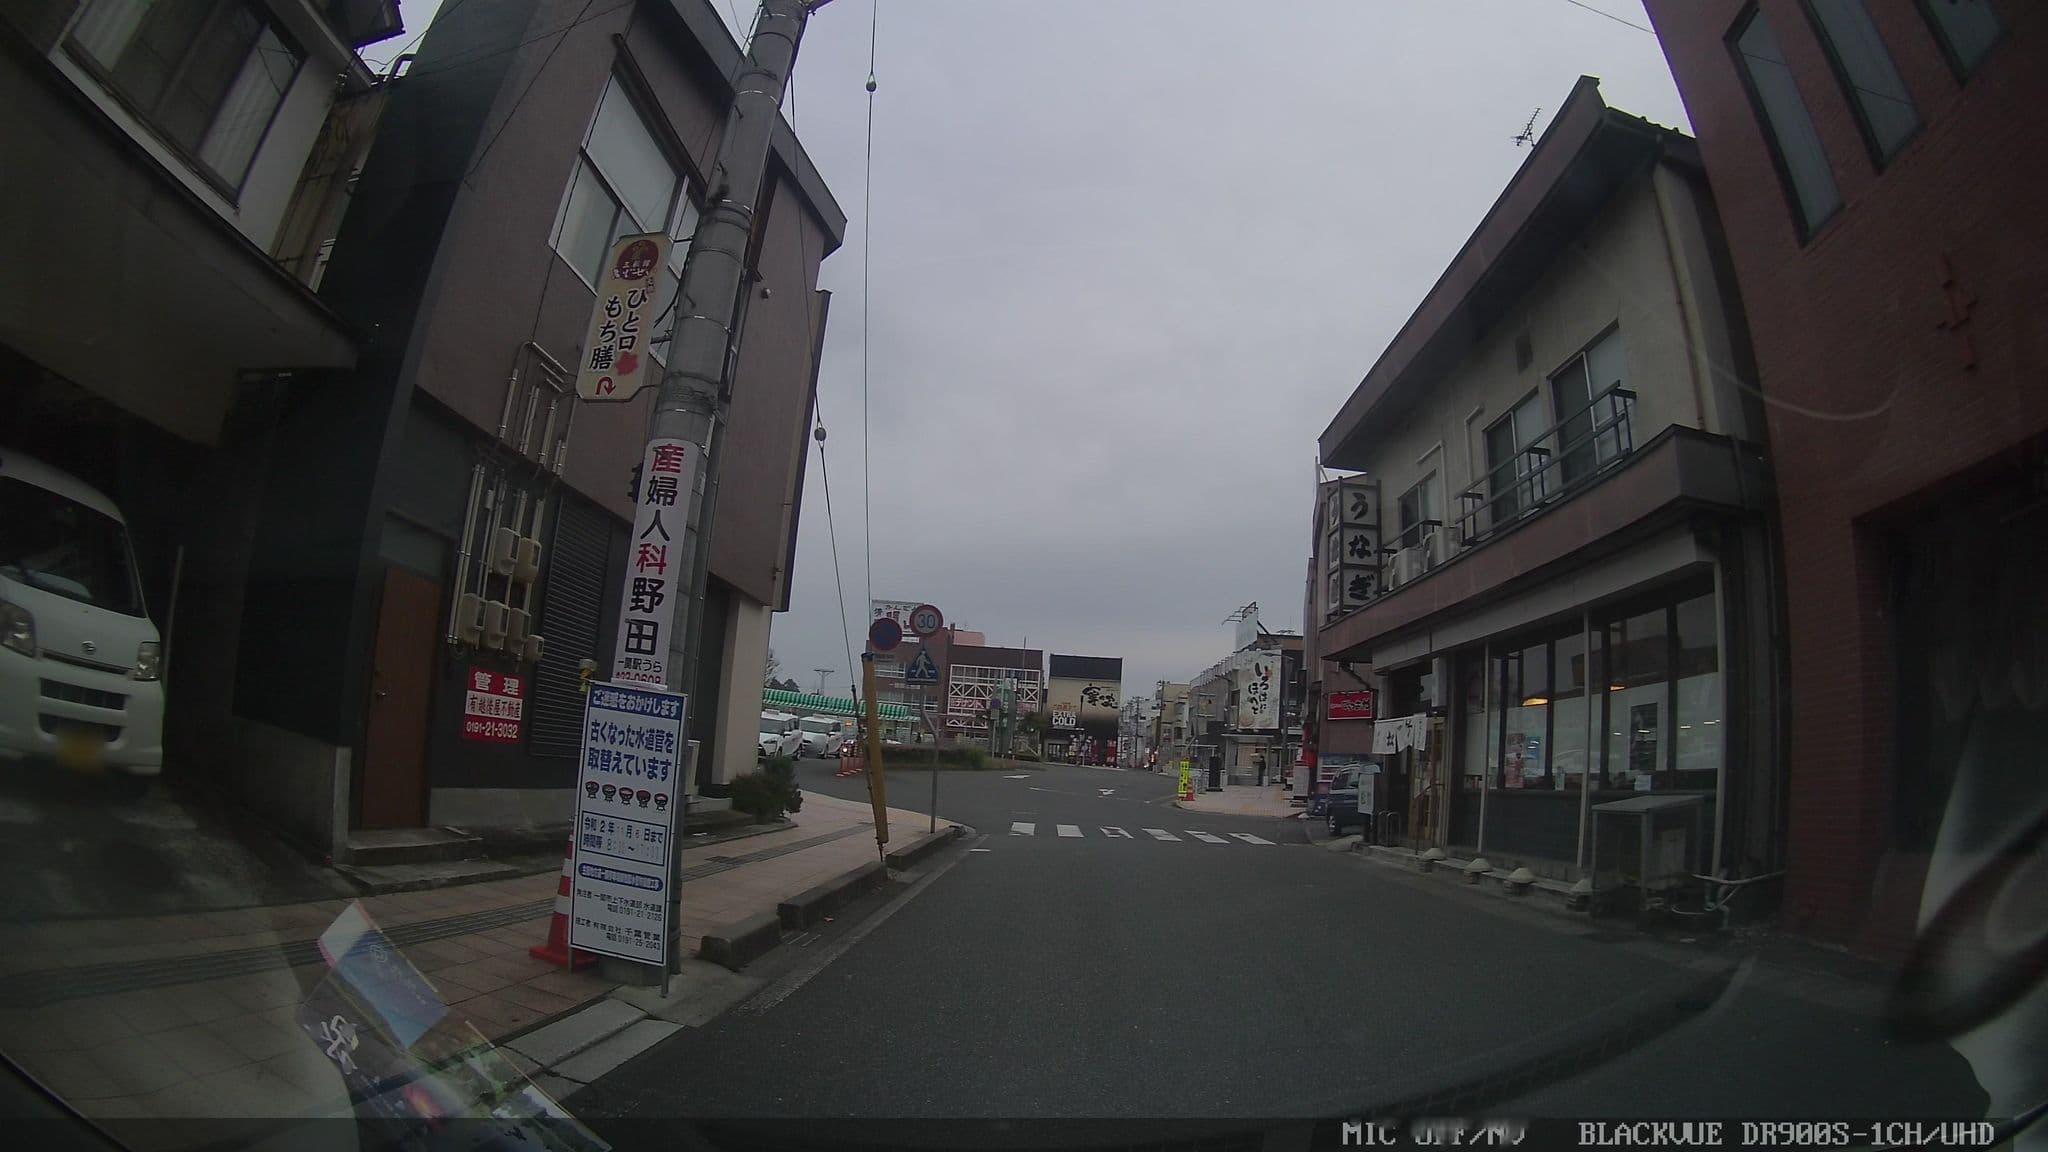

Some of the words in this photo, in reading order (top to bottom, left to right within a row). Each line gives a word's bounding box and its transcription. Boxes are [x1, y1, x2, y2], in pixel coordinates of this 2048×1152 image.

[588, 296, 623, 370] もち膳
[617, 288, 649, 352] ひと口
[625, 443, 685, 657] 産婦人科野田
[1349, 492, 1375, 601] うなぎ
[917, 614, 937, 629] 30
[474, 672, 519, 696] 管理
[593, 689, 680, 717] ご迷惑をおかけします
[590, 720, 674, 754] 古くなった水道管を
[1052, 716, 1076, 726] COLD
[587, 747, 672, 782] 取替えています
